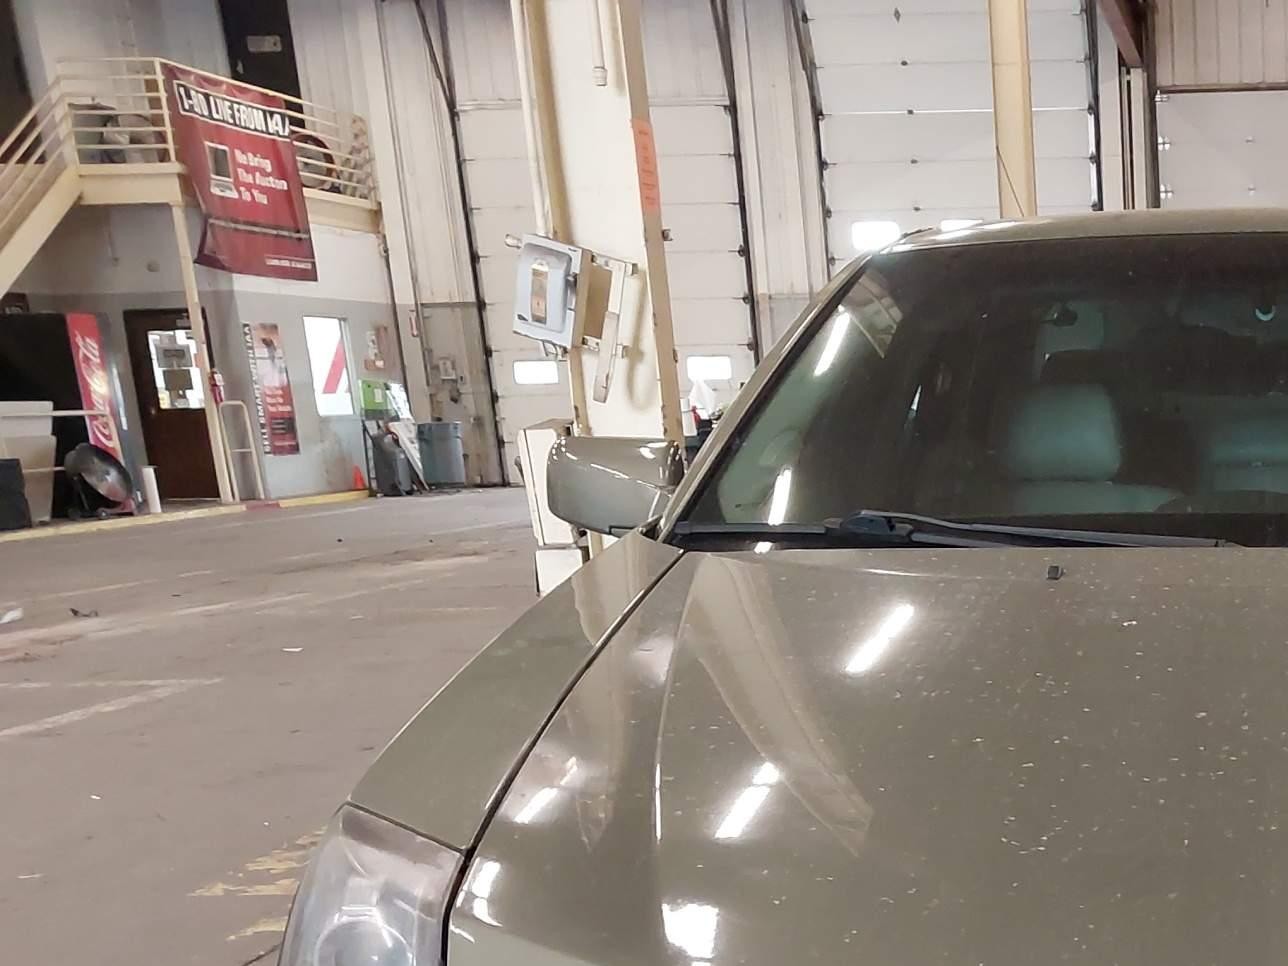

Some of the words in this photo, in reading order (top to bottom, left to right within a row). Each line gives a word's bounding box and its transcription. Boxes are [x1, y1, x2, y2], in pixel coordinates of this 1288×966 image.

[209, 95, 234, 124] LIVE
[233, 103, 266, 132] FROM
[247, 152, 272, 173] Bring
[237, 168, 254, 184] The
[255, 171, 288, 191] Auction
[239, 186, 252, 202] To
[251, 188, 268, 205] You
[243, 325, 253, 347] IAA
